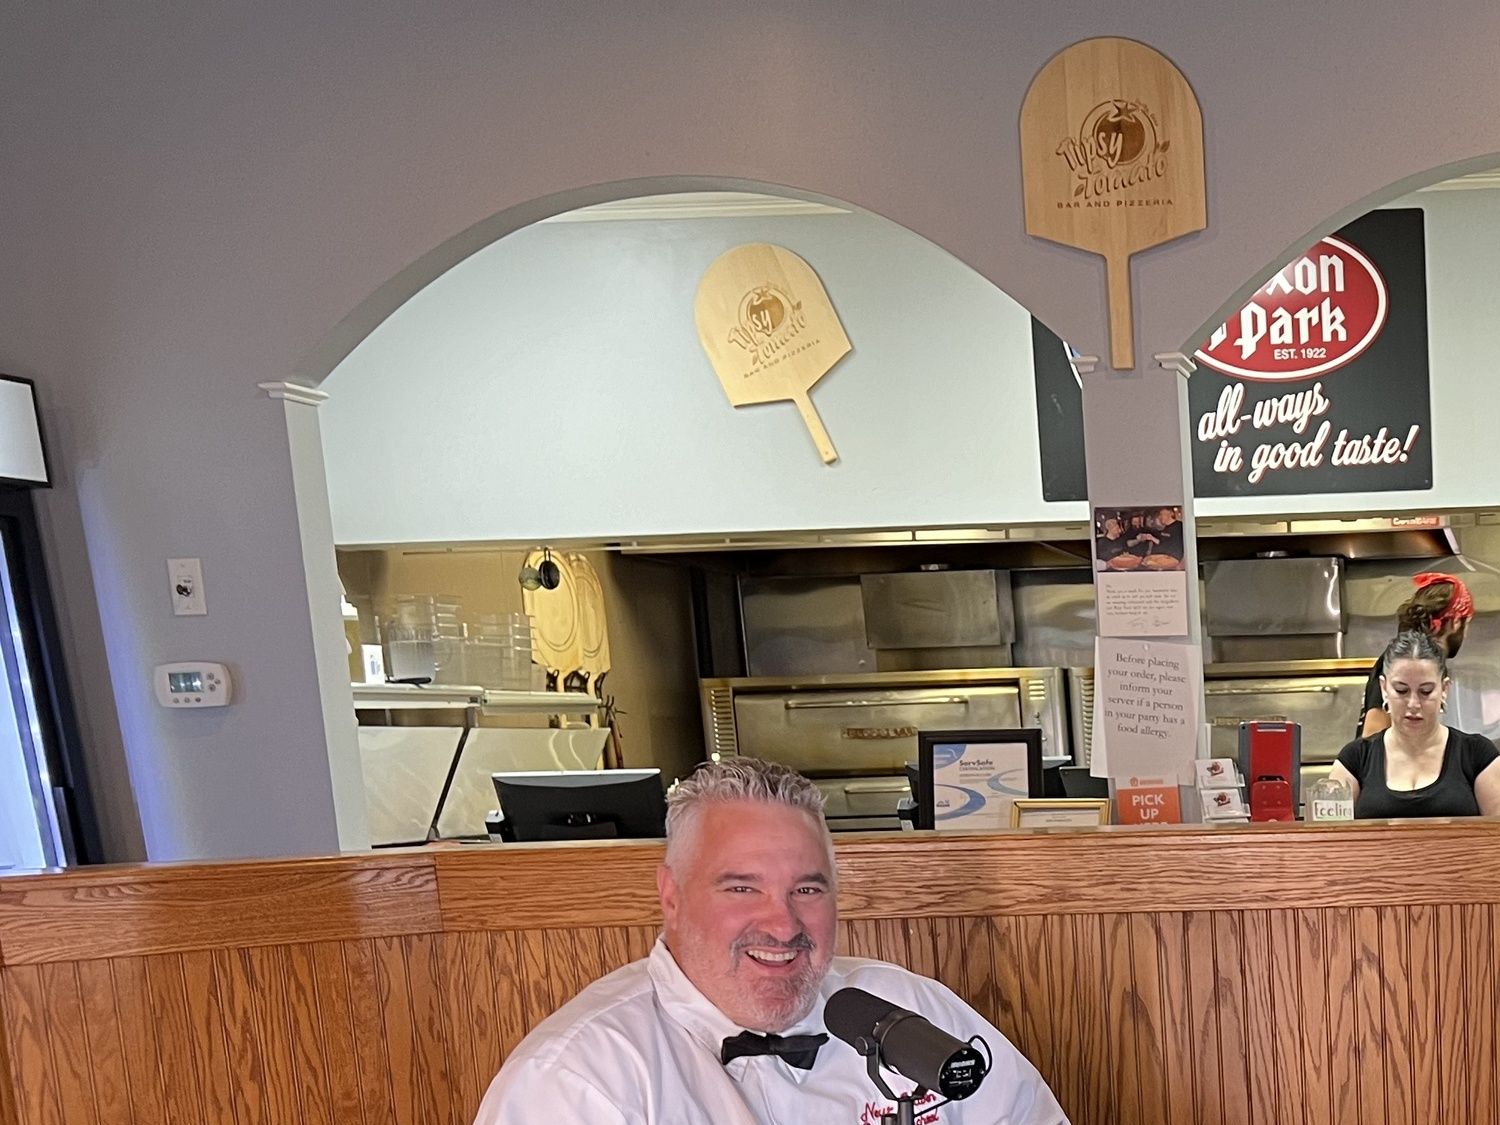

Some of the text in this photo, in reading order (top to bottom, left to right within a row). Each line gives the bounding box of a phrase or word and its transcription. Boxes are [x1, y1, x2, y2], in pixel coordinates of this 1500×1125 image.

[1056, 132, 1123, 174] Tipsy
[1078, 153, 1168, 199] Tomato
[1086, 200, 1110, 208] AND
[1117, 199, 1173, 208] PIZZERIA
[1233, 296, 1348, 360] Park
[1273, 348, 1326, 360] EST. 1922
[1198, 381, 1330, 442] all-ways
[1213, 420, 1420, 484] in good taste!
[1116, 653, 1180, 671] Before placing
[1107, 668, 1186, 683] your order, please
[1120, 682, 1173, 697] inform your
[1108, 695, 1135, 706] server
[1136, 697, 1144, 707] if
[1153, 701, 1184, 711] person
[1104, 708, 1113, 717] in
[1115, 711, 1136, 720] your
[1137, 714, 1160, 725] party
[1162, 714, 1178, 724] has
[1117, 723, 1138, 734] food
[1132, 793, 1165, 806] PICK
[1140, 808, 1159, 820] UP
